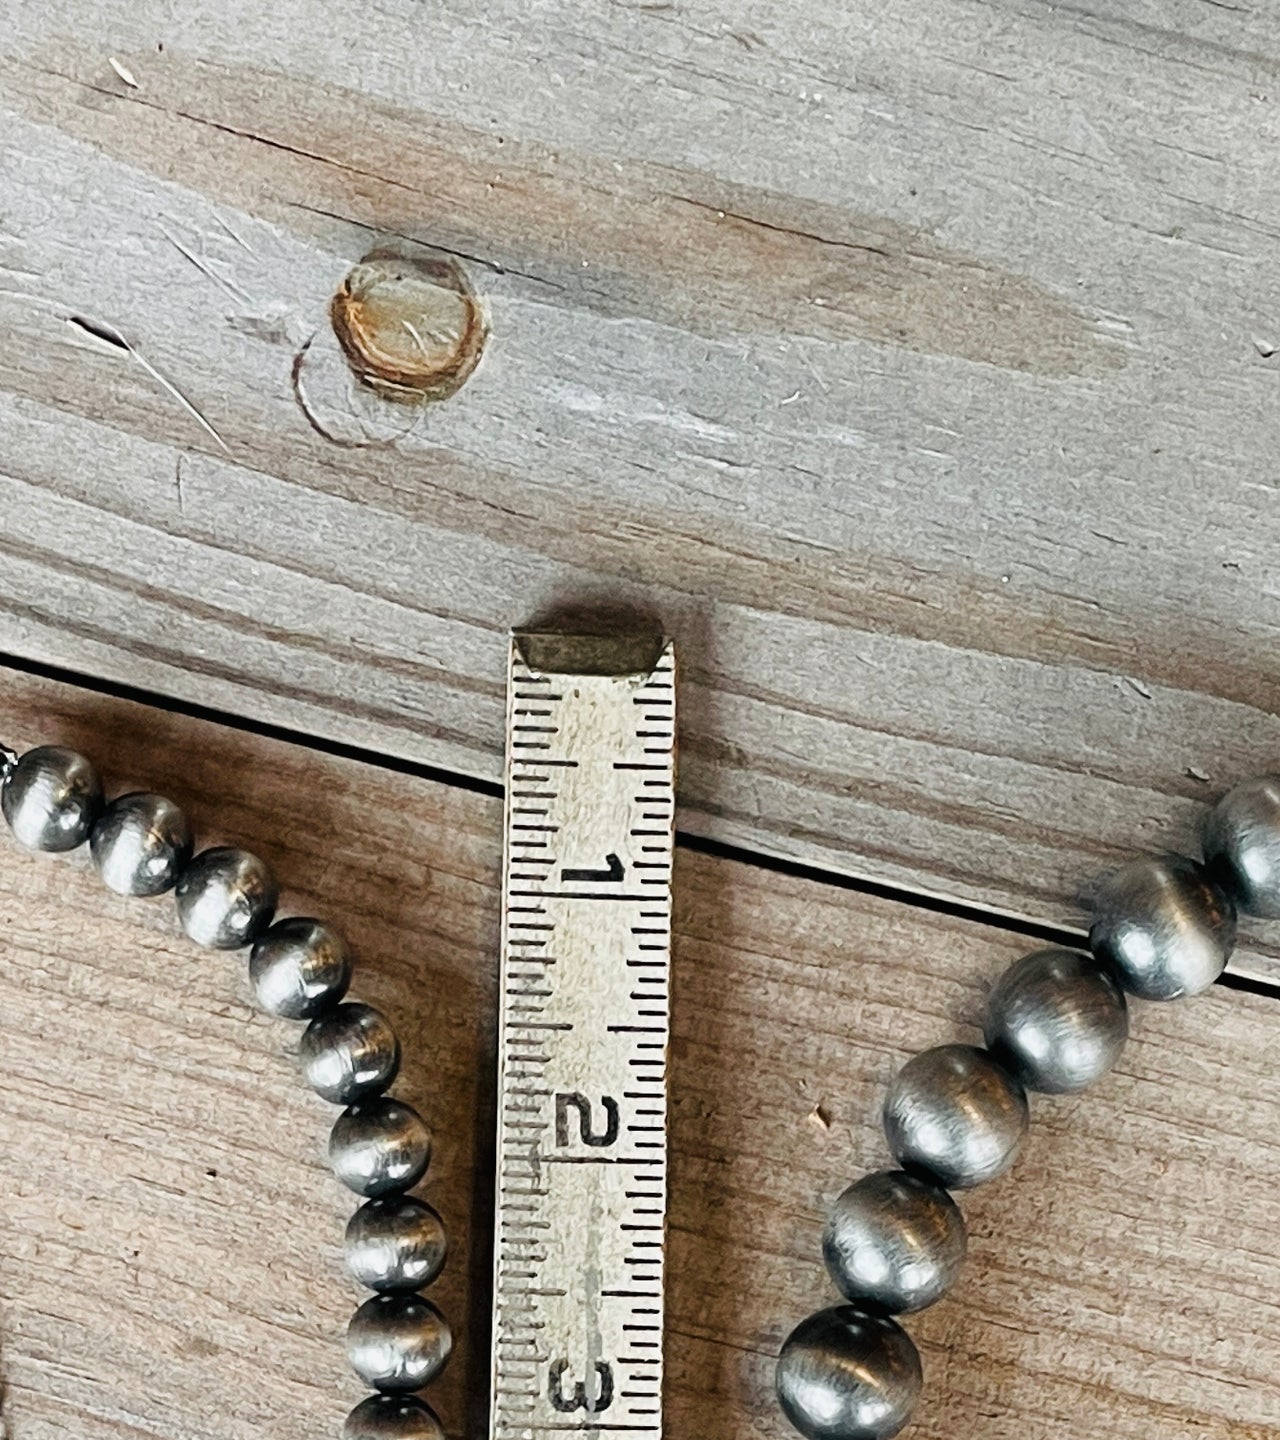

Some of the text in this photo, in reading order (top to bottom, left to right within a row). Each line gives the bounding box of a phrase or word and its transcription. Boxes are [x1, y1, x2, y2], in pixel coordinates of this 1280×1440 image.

[560, 853, 625, 882] 1
[555, 1091, 620, 1147] 2
[547, 1358, 614, 1413] 3
